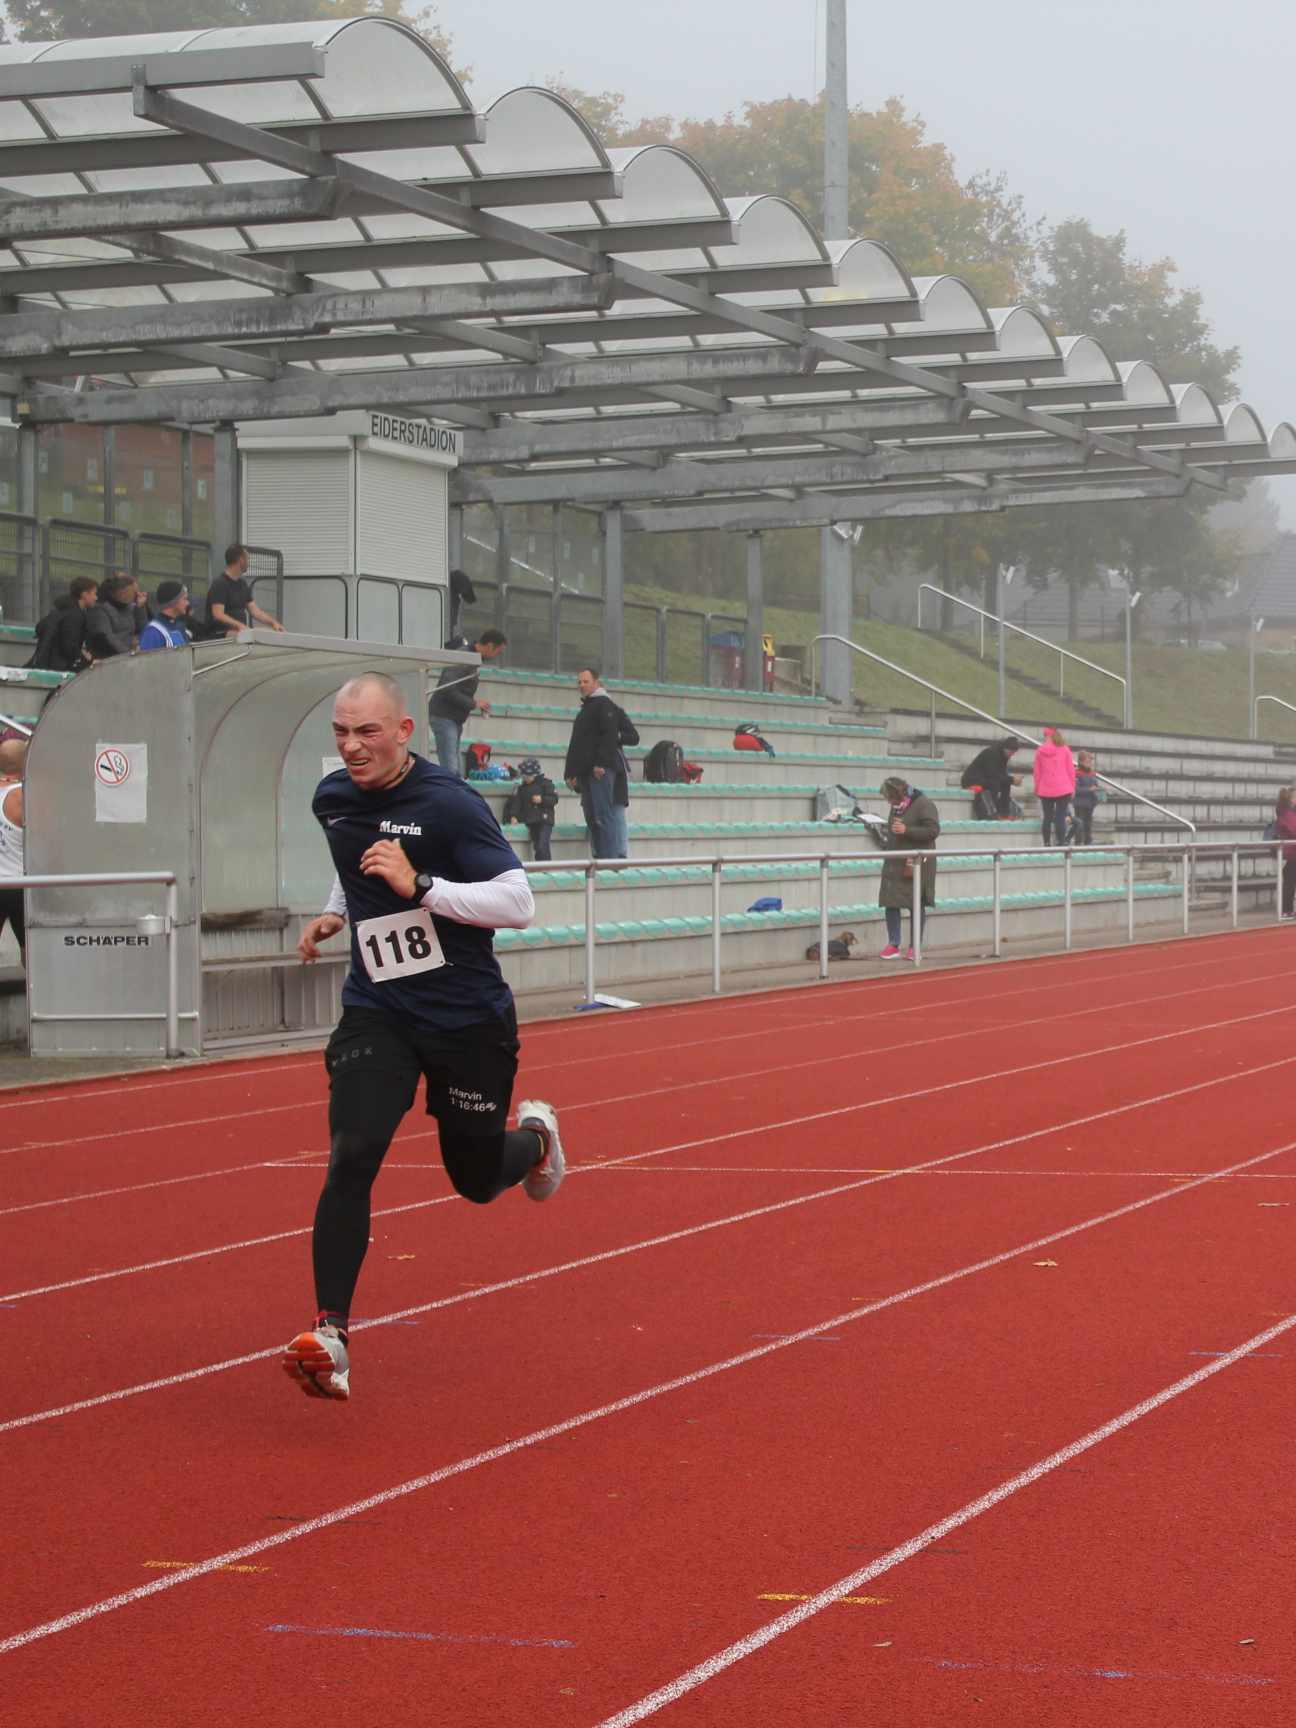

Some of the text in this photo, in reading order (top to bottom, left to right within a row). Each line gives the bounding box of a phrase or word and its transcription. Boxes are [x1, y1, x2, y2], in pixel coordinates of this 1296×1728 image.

[371, 414, 456, 454] EIDERSTADION
[379, 820, 422, 836] Marvin
[366, 926, 432, 968] 118
[449, 1087, 482, 1101] Marvin
